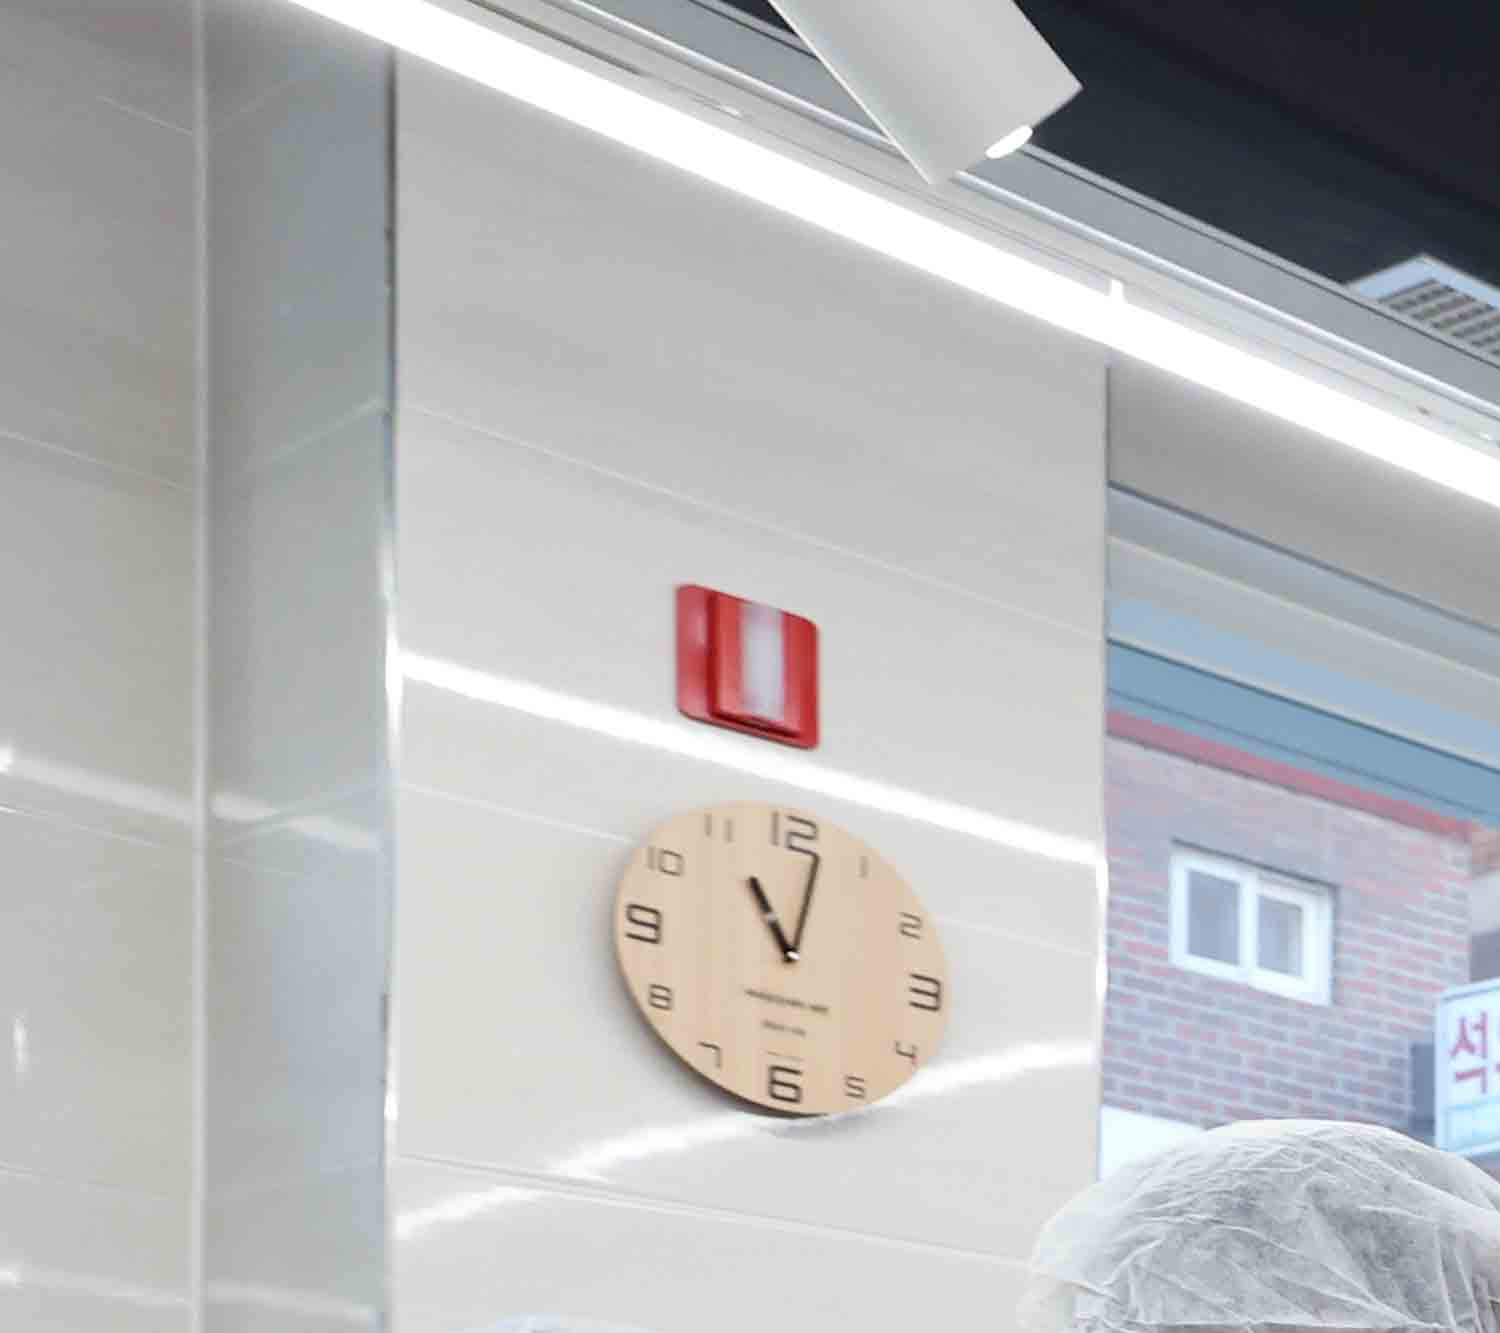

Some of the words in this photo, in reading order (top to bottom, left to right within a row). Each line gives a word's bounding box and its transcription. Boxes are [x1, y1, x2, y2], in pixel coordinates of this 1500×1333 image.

[771, 811, 818, 853] 12
[647, 845, 684, 876] 10
[626, 903, 662, 943] 9
[899, 911, 922, 939] 2
[648, 983, 673, 1010] 8
[908, 972, 941, 1012] 3
[697, 1040, 721, 1068] 7
[768, 1065, 803, 1104] 6
[846, 1075, 866, 1099] 5
